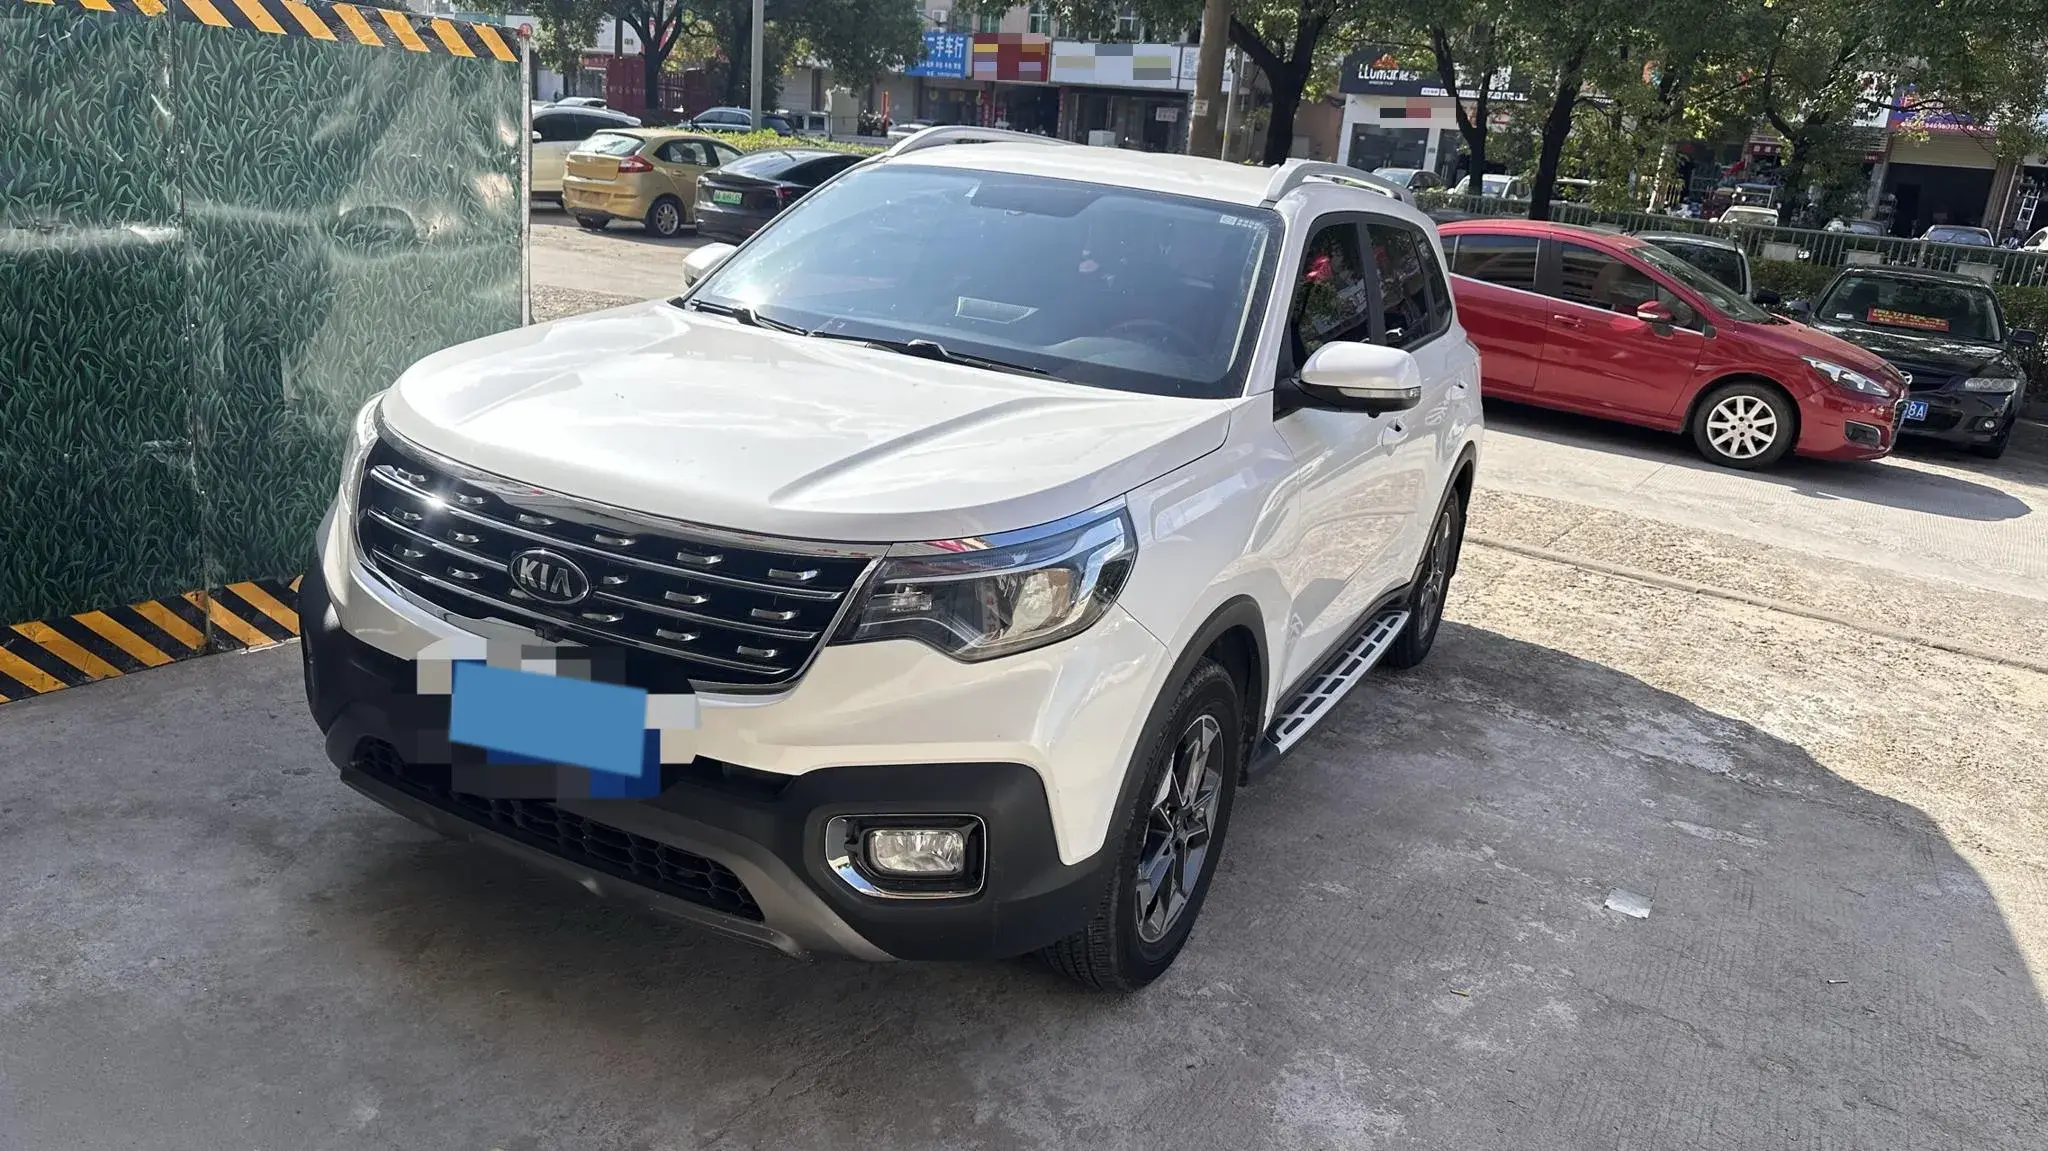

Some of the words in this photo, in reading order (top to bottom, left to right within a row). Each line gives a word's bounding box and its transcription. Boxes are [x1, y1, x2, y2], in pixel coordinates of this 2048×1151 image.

[923, 36, 964, 58] 二手车行
[520, 557, 572, 598] KIA
